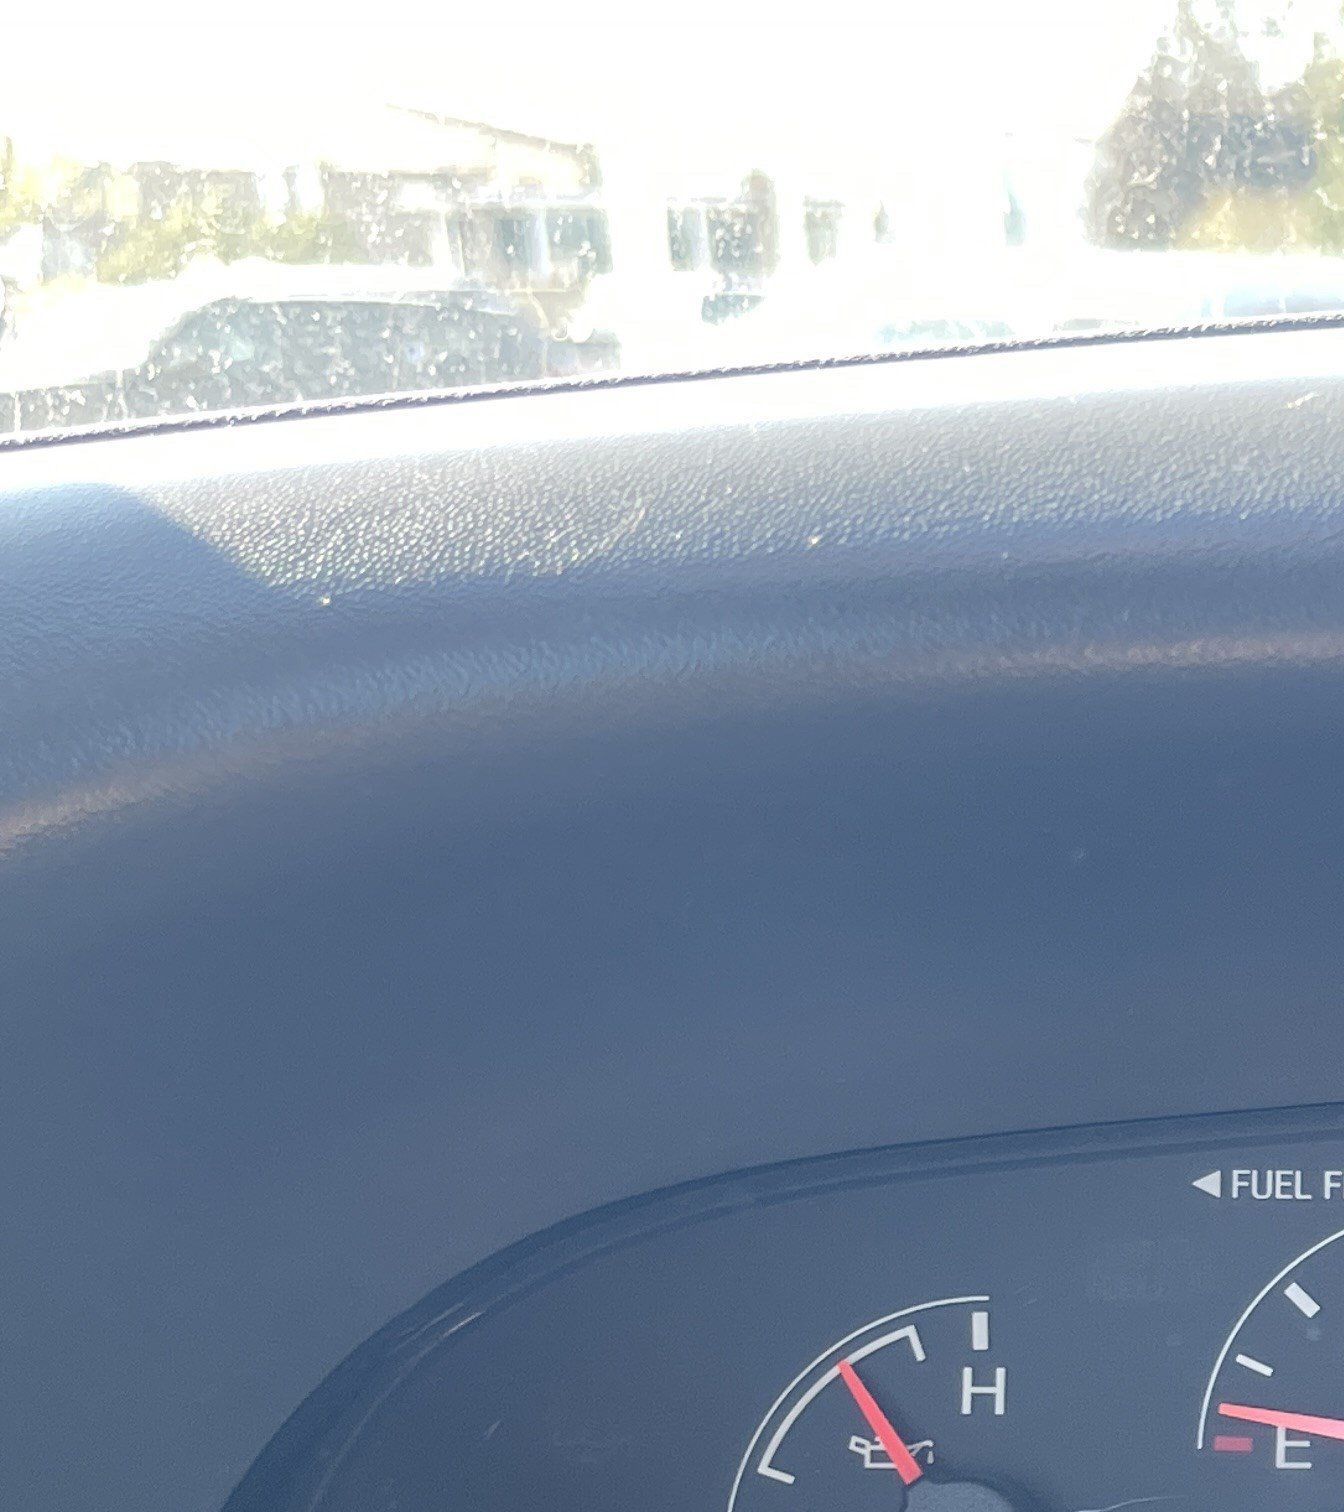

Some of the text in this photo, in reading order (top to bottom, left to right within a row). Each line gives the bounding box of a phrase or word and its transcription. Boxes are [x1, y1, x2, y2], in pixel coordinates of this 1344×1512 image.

[1231, 1169, 1313, 1200] FUEL
[961, 1366, 1006, 1415] H
[1275, 1427, 1312, 1469] E
